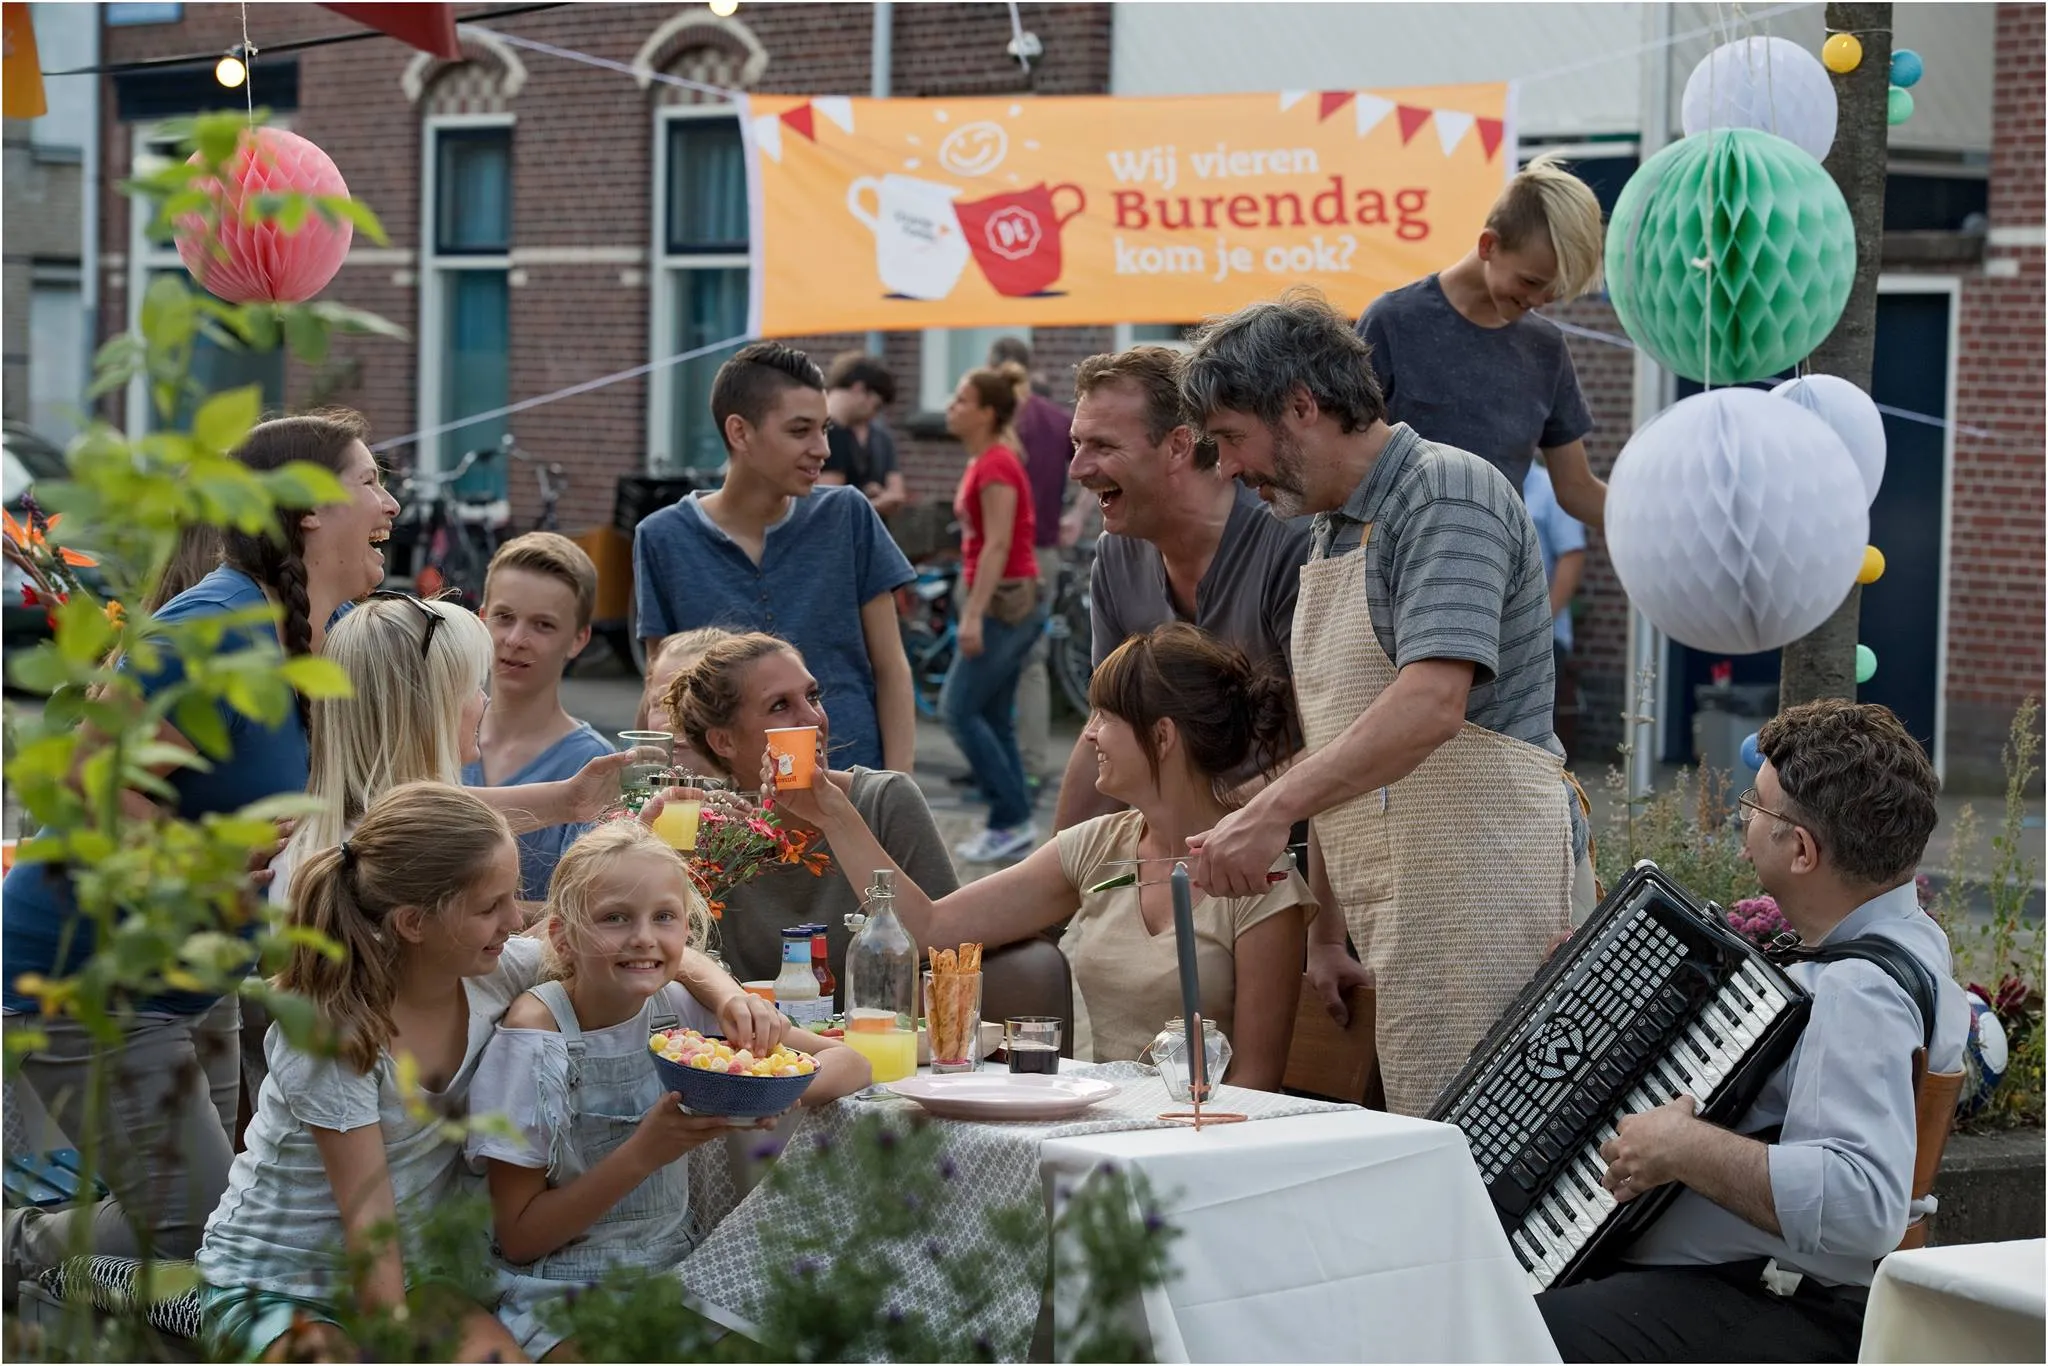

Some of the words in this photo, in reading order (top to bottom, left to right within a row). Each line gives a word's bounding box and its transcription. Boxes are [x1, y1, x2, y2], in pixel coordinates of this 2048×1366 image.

[1107, 144, 1178, 190] Wij
[1190, 143, 1320, 179] vieren
[1110, 174, 1431, 242] Burendag
[1114, 236, 1206, 274] kom
[1213, 236, 1254, 284] je
[1263, 235, 1358, 272] ook?
